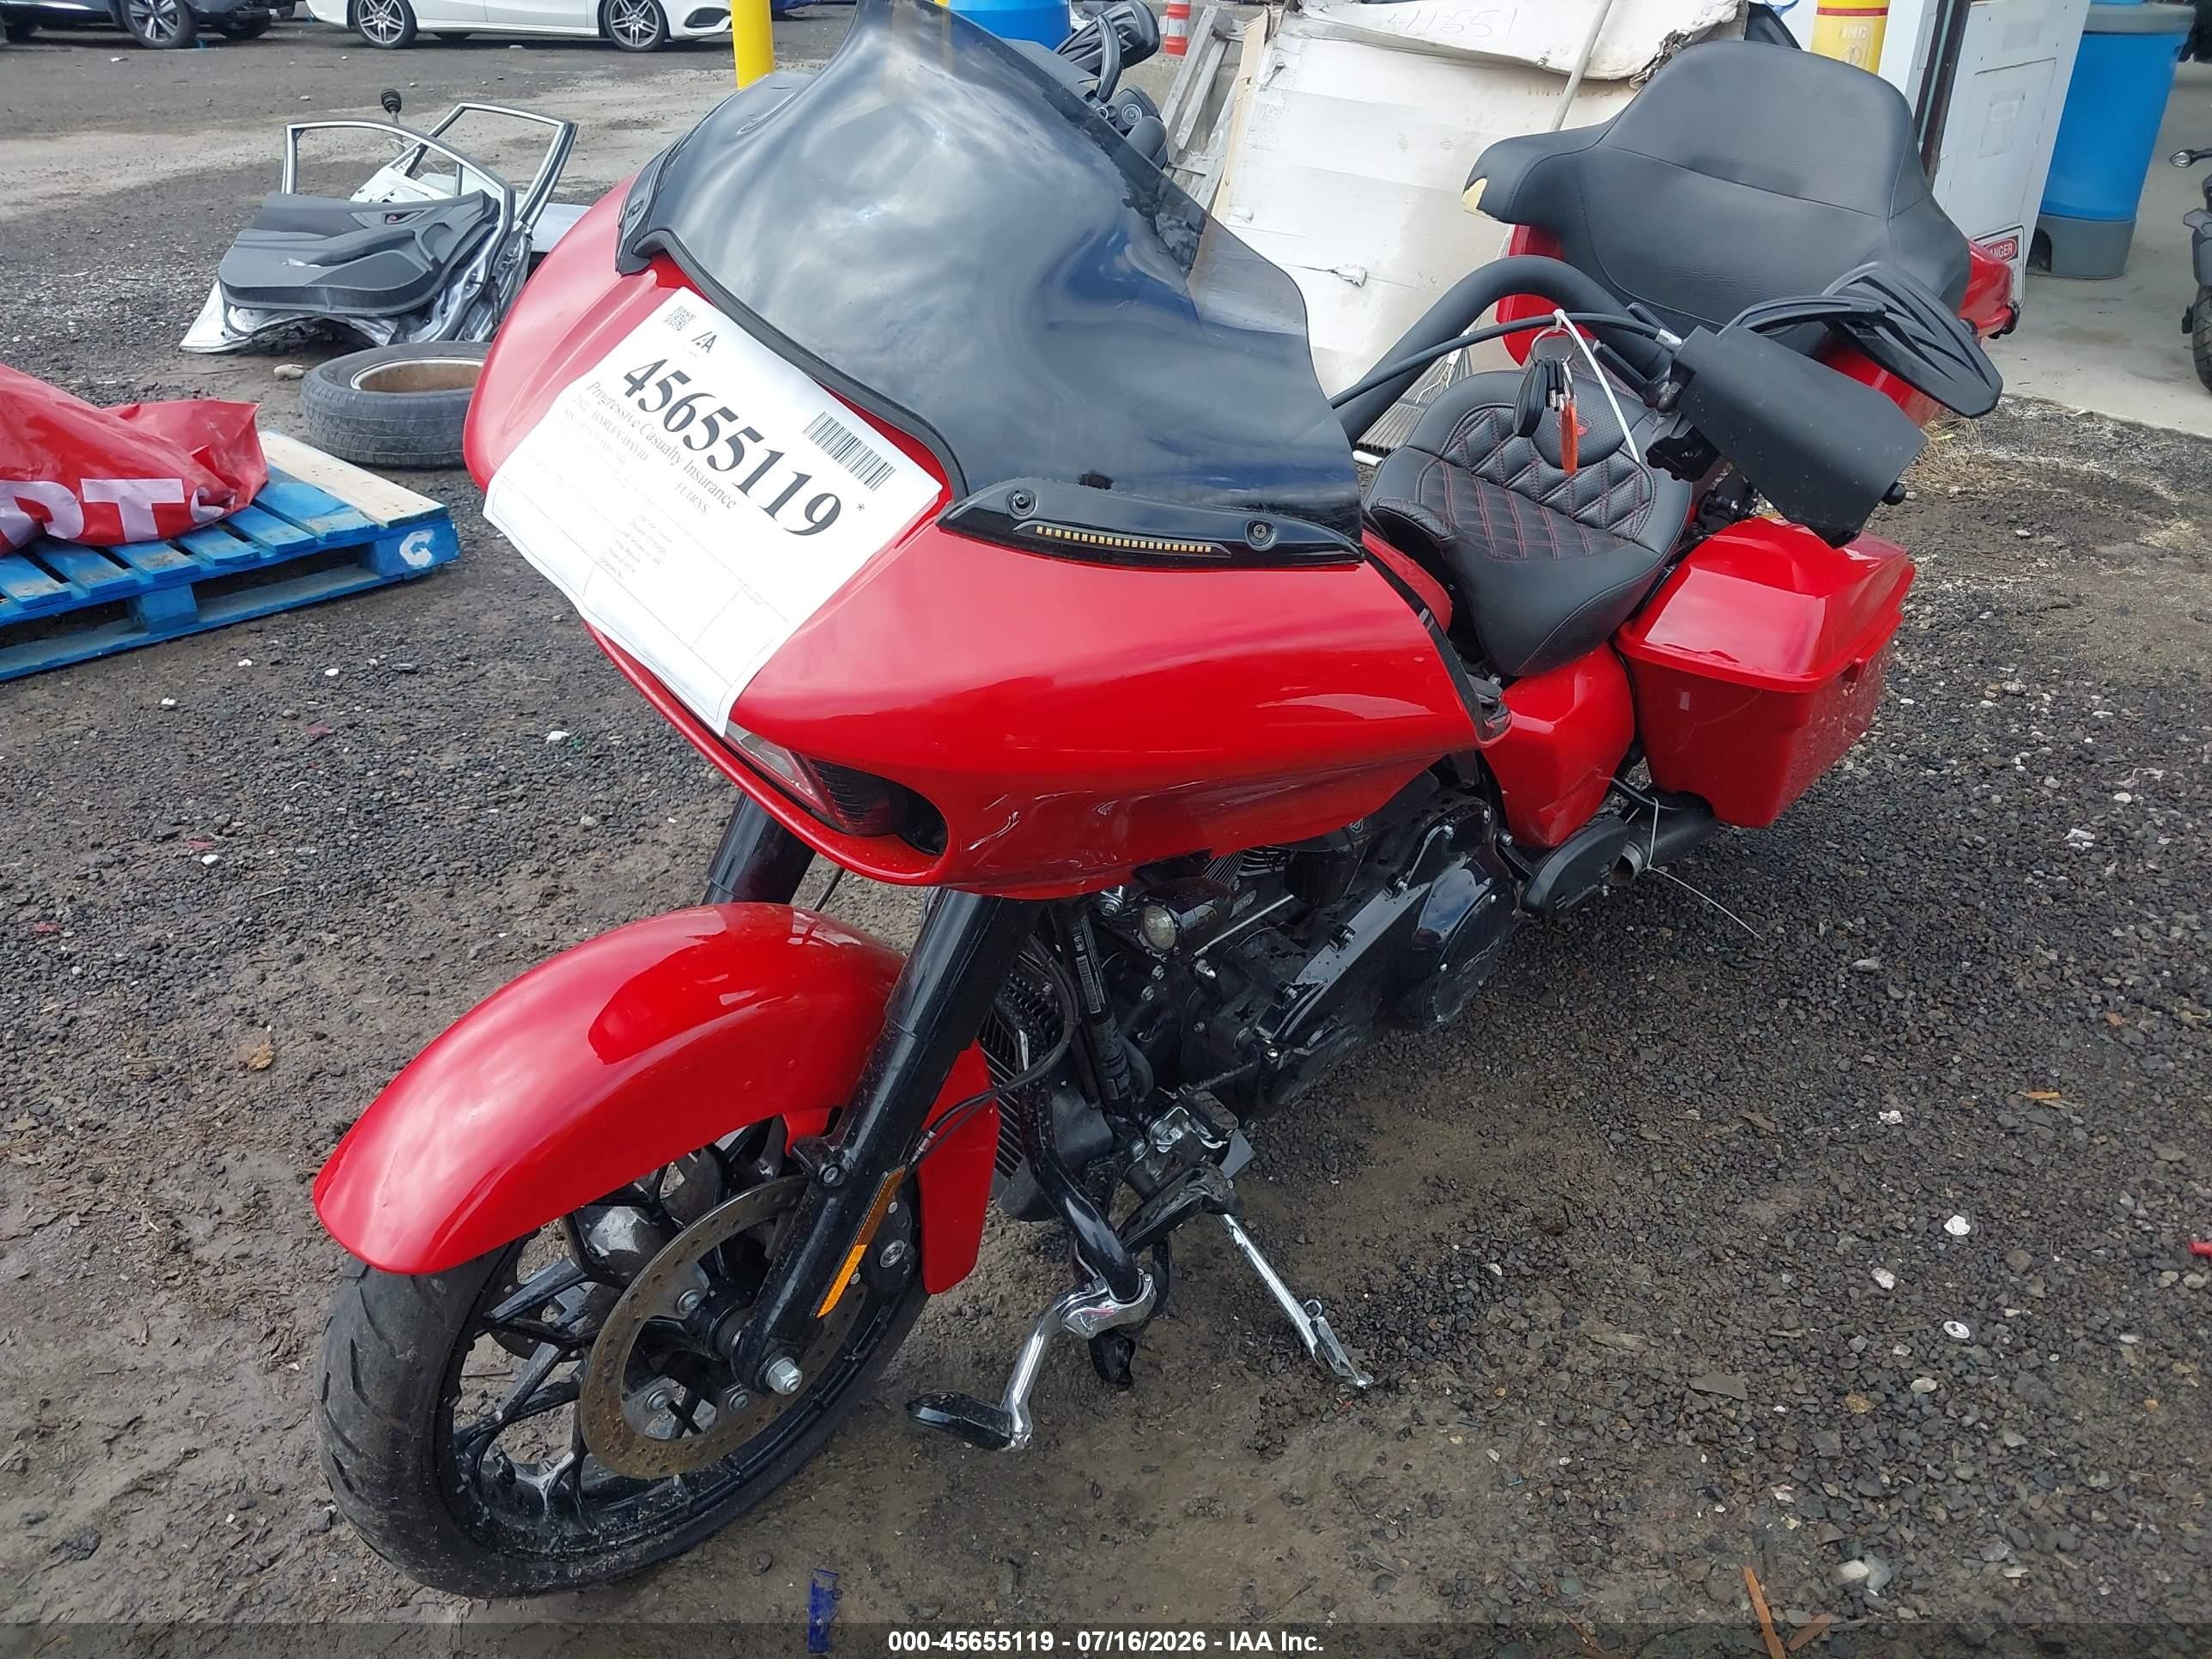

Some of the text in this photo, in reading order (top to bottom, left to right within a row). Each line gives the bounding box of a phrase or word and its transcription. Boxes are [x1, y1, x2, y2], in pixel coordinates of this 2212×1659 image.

[1990, 243, 2014, 258] ANGER
[586, 381, 641, 428] Progressive
[640, 423, 684, 466] Casualty
[683, 459, 737, 509] Insurance
[623, 357, 842, 537] 45655119
